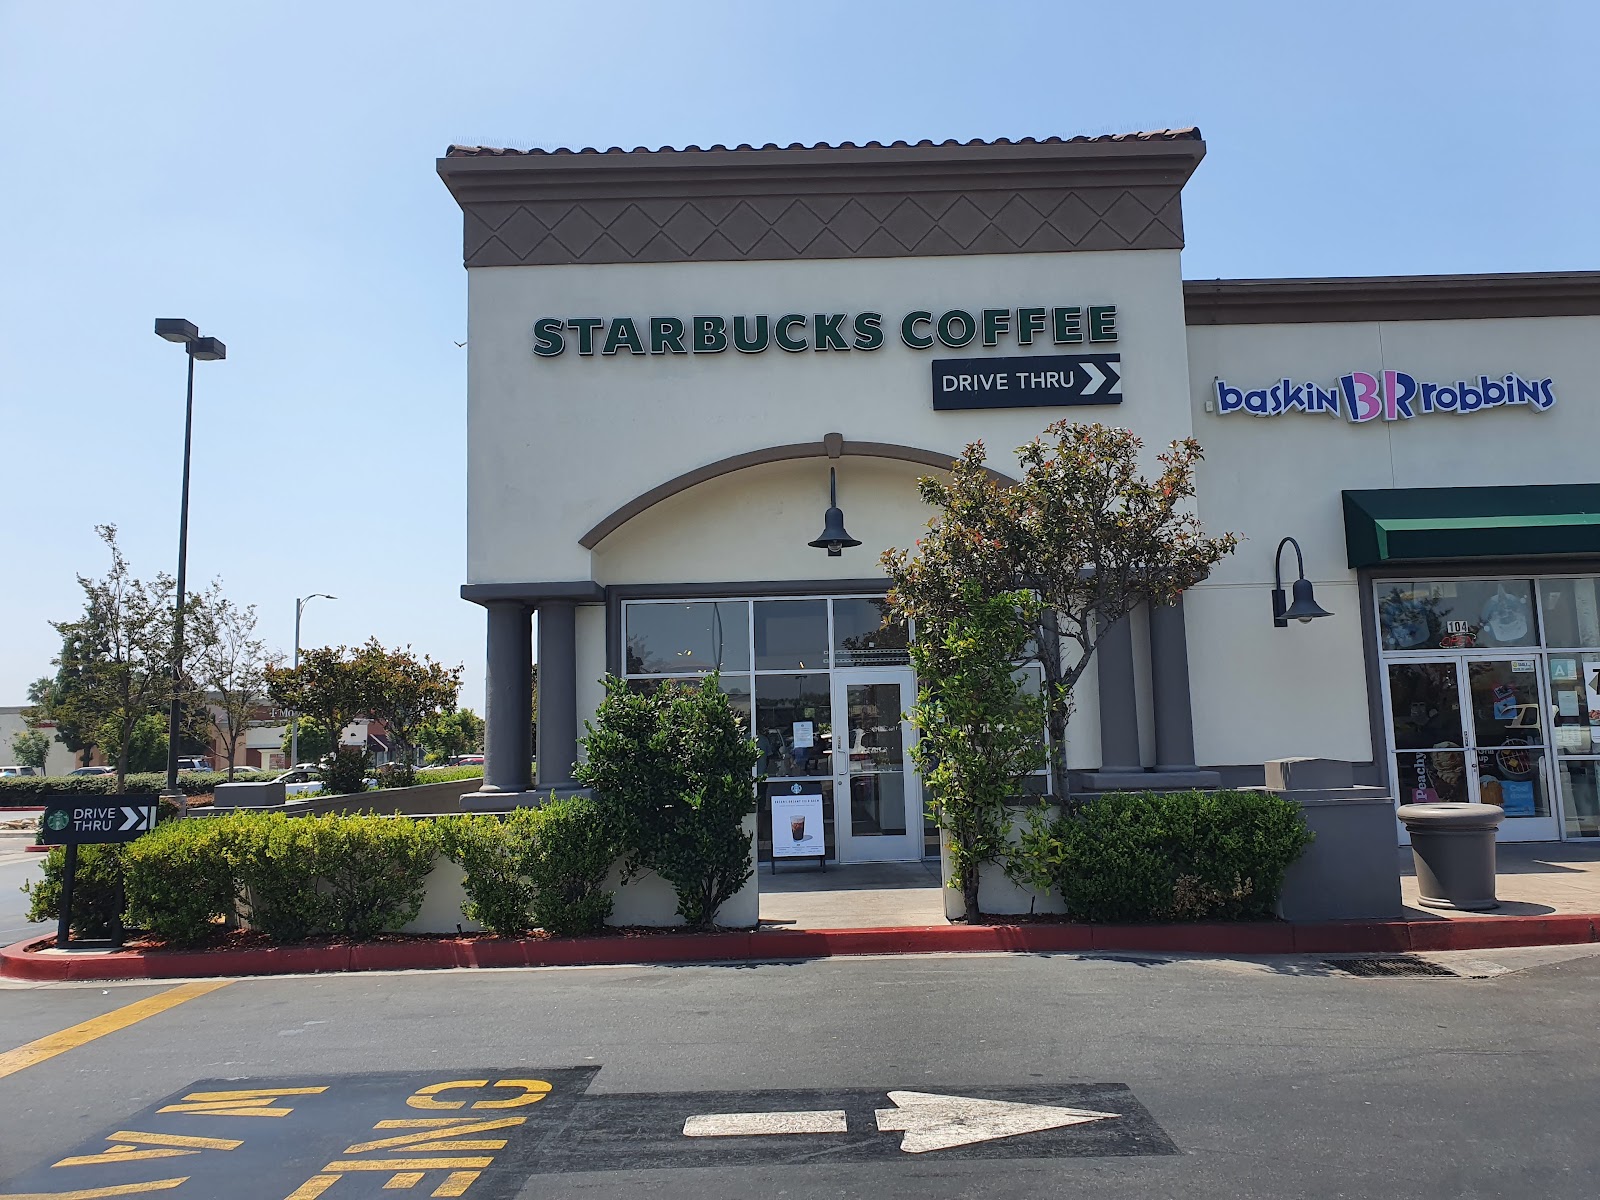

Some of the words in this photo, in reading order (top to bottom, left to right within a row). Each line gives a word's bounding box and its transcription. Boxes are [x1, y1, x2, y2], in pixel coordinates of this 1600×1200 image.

[532, 312, 885, 356] STARBUCKS
[900, 305, 1119, 349] COFFEE
[942, 372, 1011, 393] DRIVE
[1016, 371, 1076, 390] THRU
[1338, 369, 1417, 423] BR
[1449, 621, 1467, 632] 104
[1441, 635, 1475, 647] OPEN
[1554, 664, 1566, 676] A
[1413, 752, 1428, 801] Peachy
[73, 808, 117, 820] DRIVE
[73, 820, 113, 831] THRU
